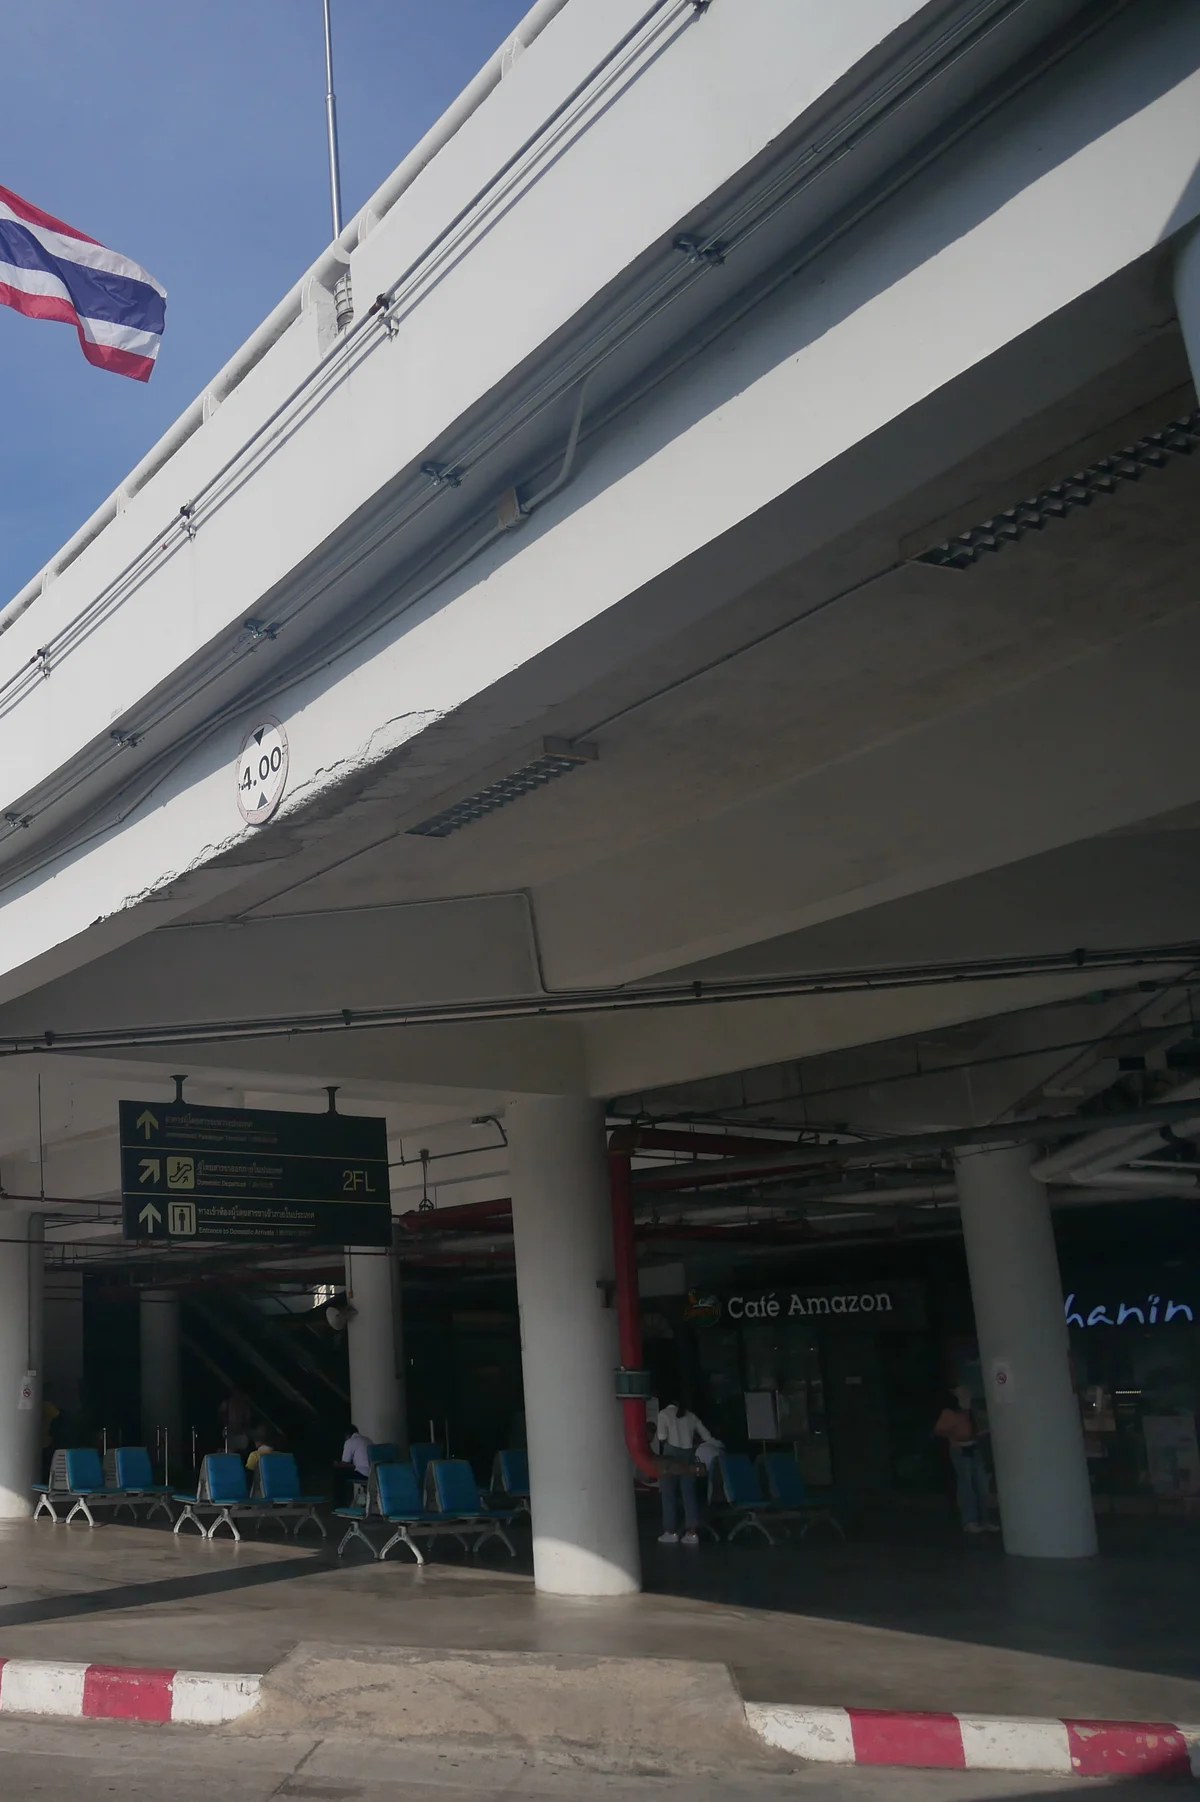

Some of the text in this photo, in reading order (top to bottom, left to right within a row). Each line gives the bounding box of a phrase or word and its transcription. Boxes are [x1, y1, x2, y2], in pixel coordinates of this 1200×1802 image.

[238, 746, 282, 791] 4.00
[196, 1179, 221, 1187] Domestic
[342, 1170, 376, 1192] 2FL
[198, 1227, 222, 1235] Entrance
[229, 1228, 254, 1236] Domestic
[255, 1229, 275, 1237] Arrivals
[728, 1292, 780, 1319] Café
[788, 1293, 893, 1316] Amazon
